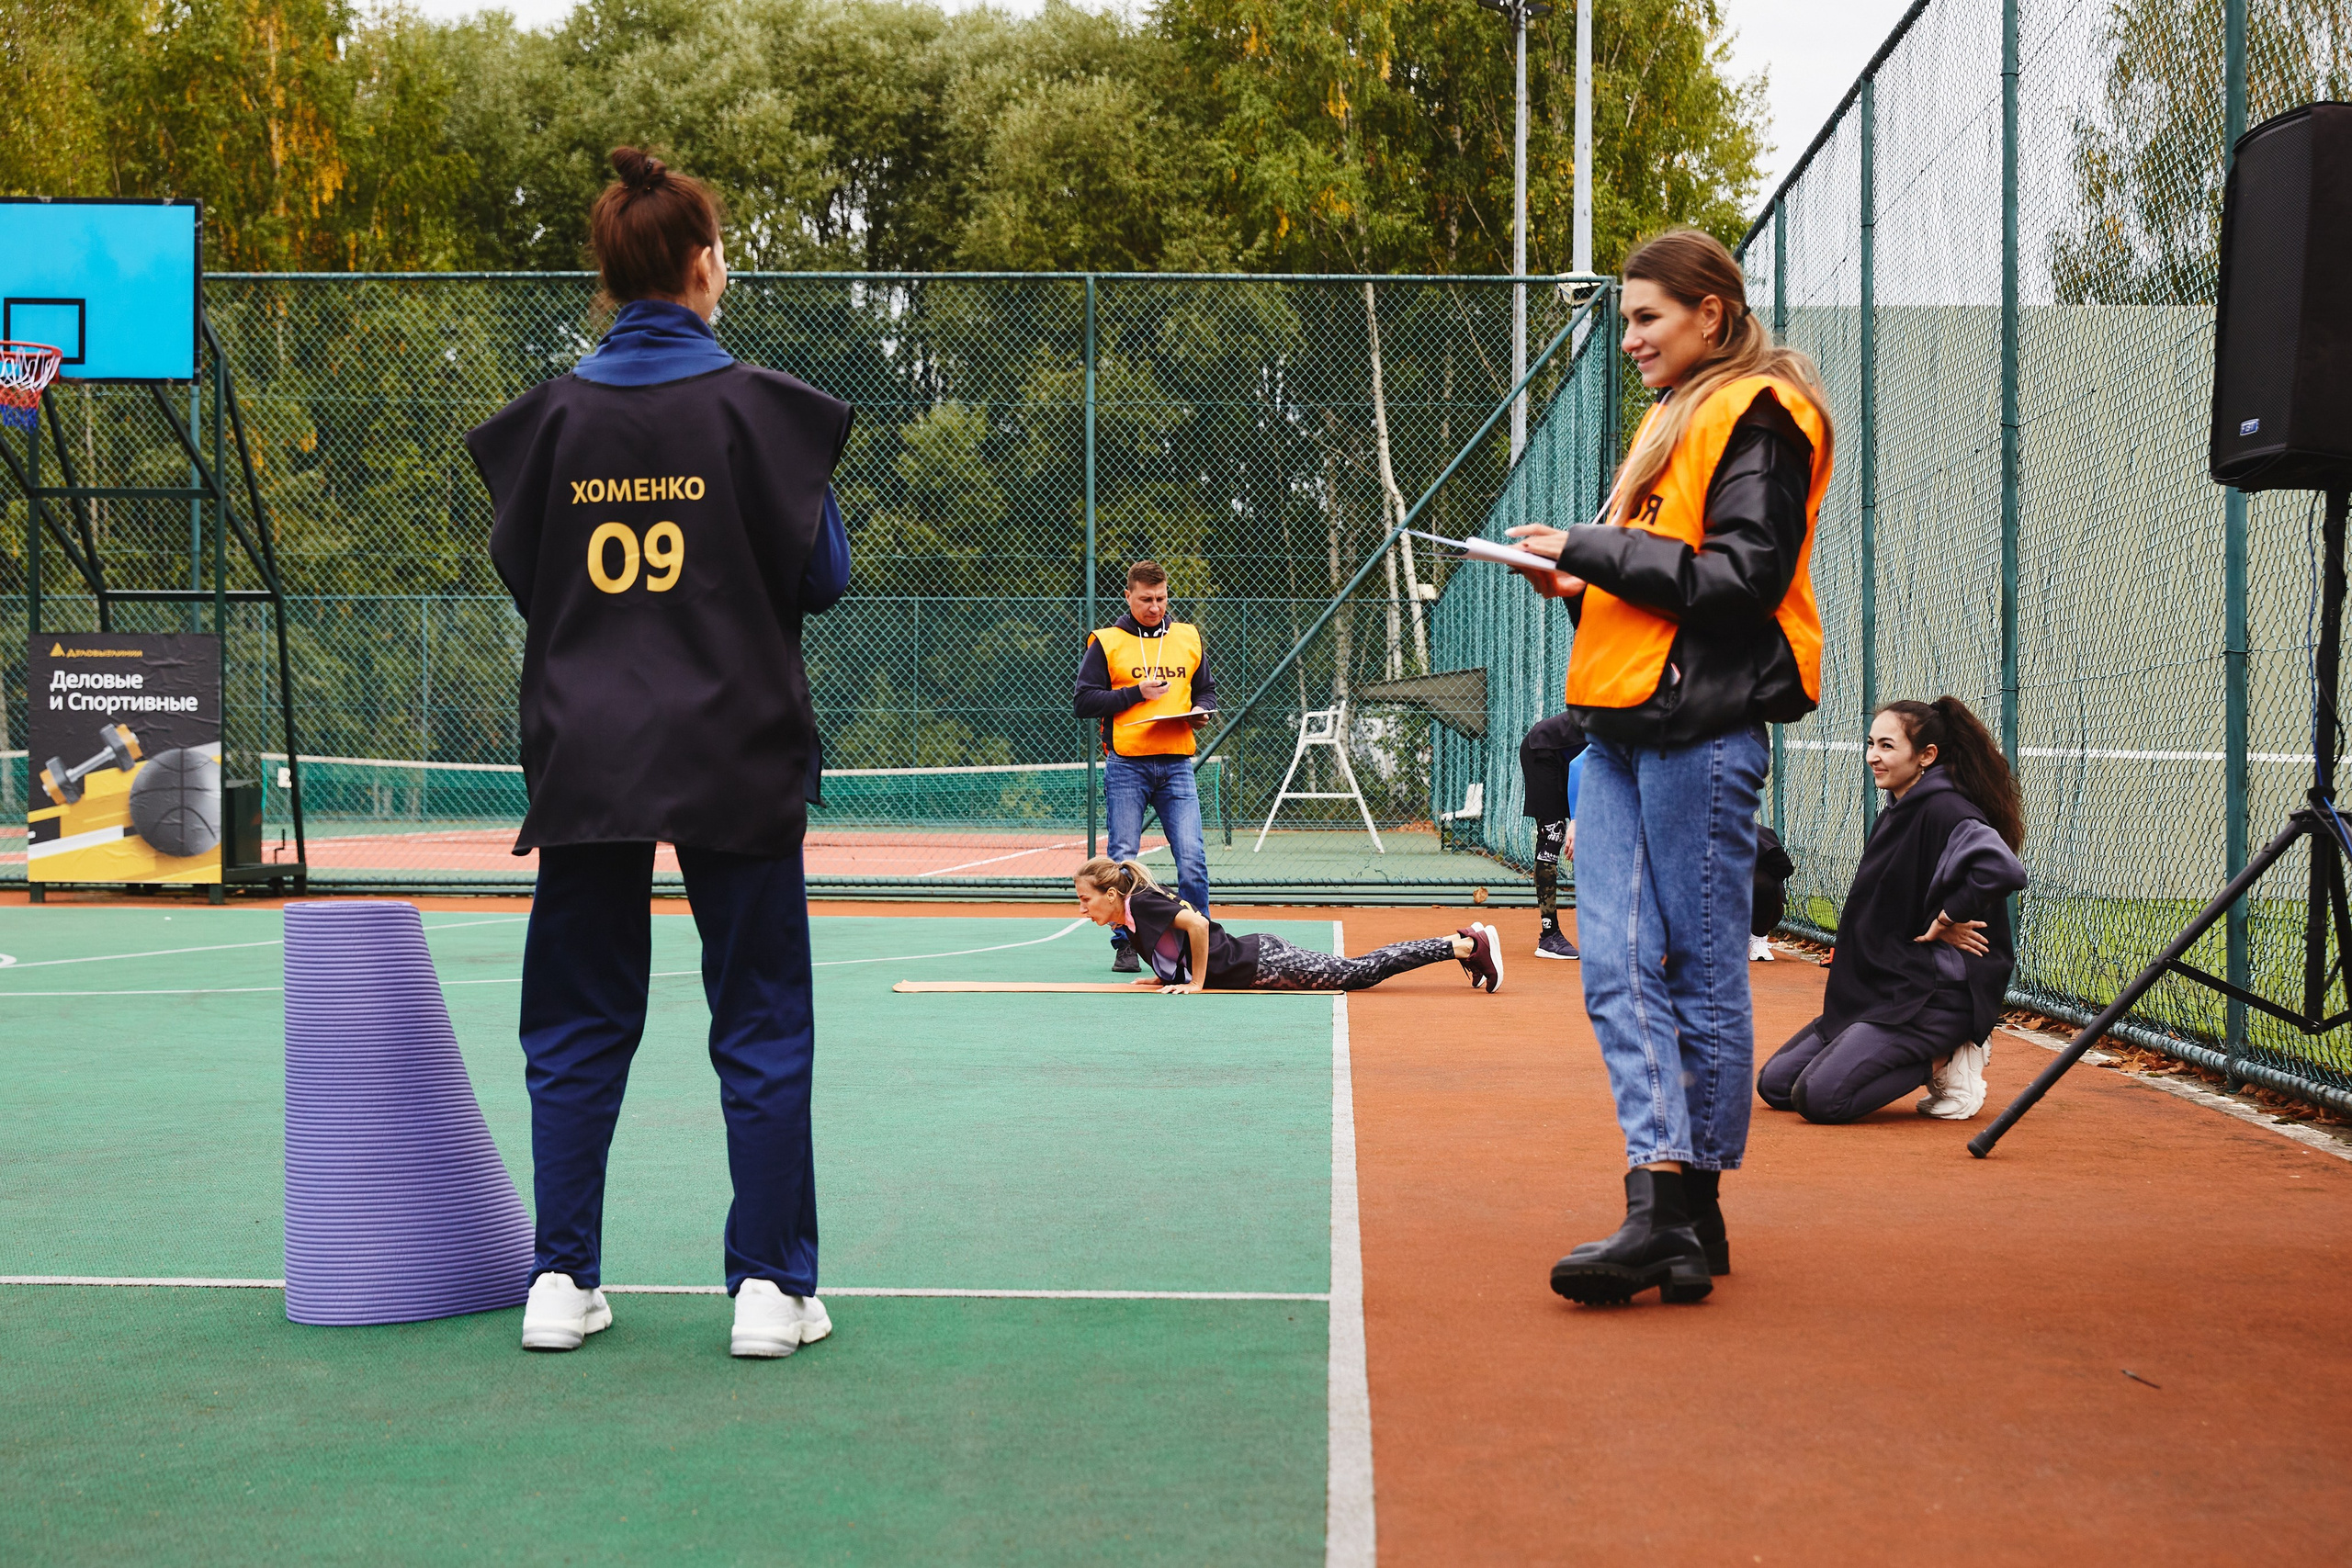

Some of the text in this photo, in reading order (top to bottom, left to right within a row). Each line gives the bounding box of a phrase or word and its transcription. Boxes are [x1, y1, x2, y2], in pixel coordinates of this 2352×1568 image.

[571, 476, 706, 504] ХОМЕНКО
[587, 521, 684, 594] 09
[50, 670, 143, 692] Деловые
[50, 693, 198, 716] и Спортивные
